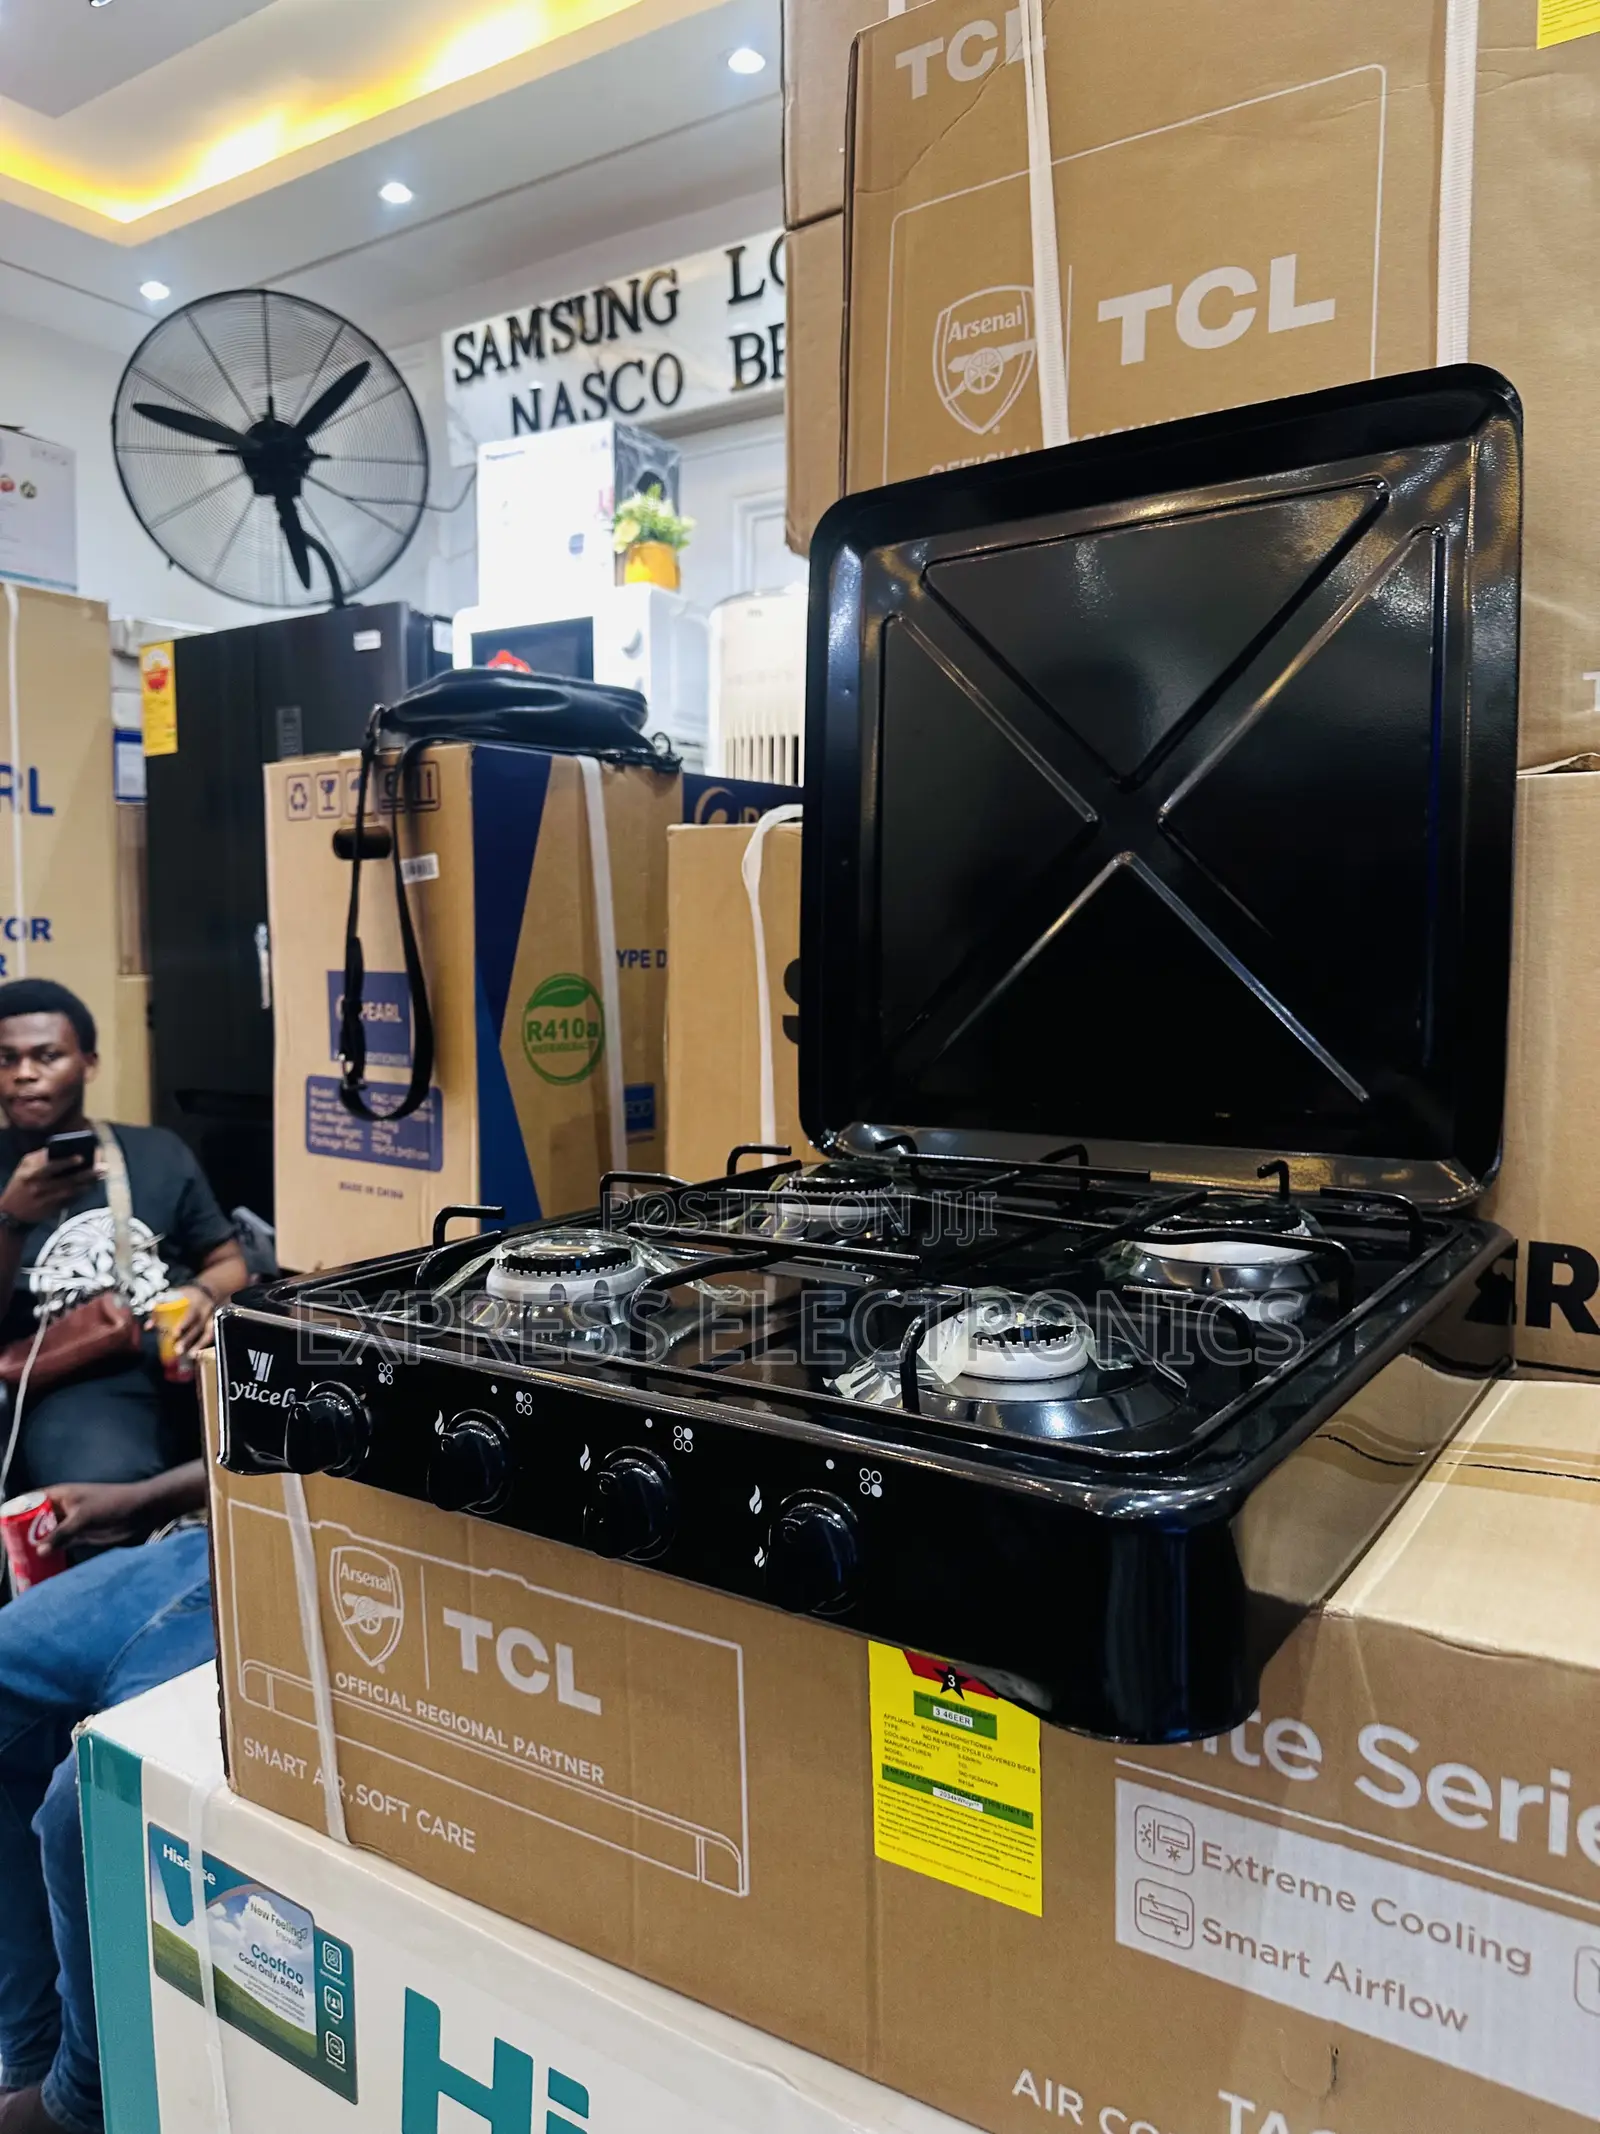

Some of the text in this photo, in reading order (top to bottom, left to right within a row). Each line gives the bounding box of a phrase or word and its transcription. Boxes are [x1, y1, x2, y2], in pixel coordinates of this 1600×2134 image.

[453, 268, 680, 384] SAMSUNG
[948, 305, 1023, 343] Arsenal
[1098, 254, 1336, 366] TCL
[511, 352, 684, 436] NASCO
[614, 950, 652, 968] YPE
[339, 1562, 393, 1592] Arsenal
[443, 1607, 602, 1716] TCL
[947, 1674, 956, 1687] 3
[335, 1672, 605, 1784] OFFICIAL REGIONAL PARTNER
[243, 1737, 308, 1780] SMART
[313, 1768, 347, 1797] AR
[416, 1809, 477, 1853] CARE
[1201, 1841, 1532, 1976] Extreme Cooling
[1202, 1918, 1469, 2032] Smart Airflow
[1012, 2068, 1083, 2126] AIR
